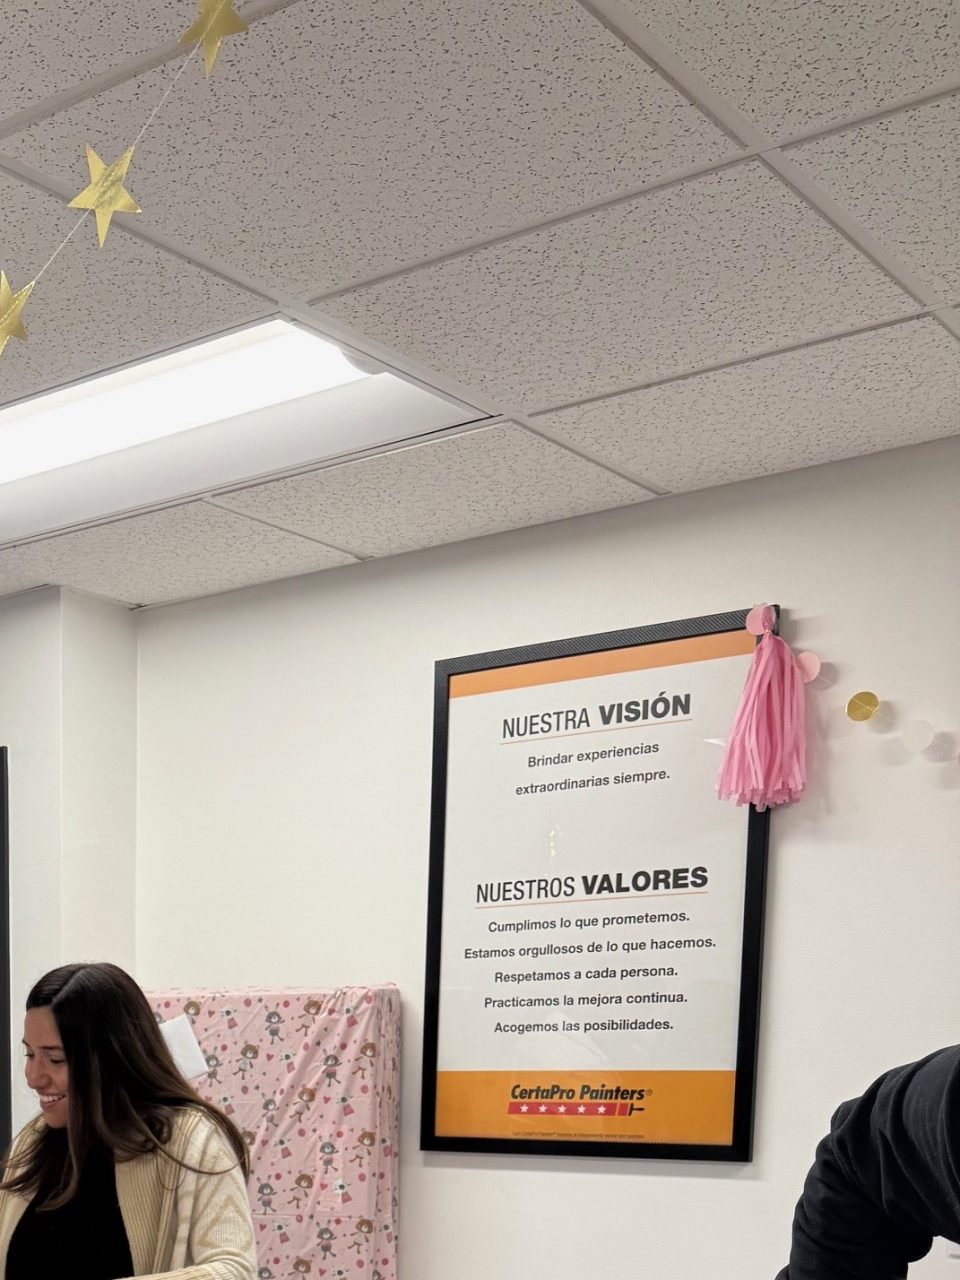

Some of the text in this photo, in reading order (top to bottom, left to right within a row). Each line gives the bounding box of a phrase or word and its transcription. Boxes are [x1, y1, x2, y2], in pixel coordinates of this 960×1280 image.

[502, 692, 691, 738] NUESTRA VISIÓN
[528, 742, 659, 768] Brindar experiencias
[516, 769, 670, 795] extraordinarias siempre.
[477, 867, 708, 903] NUESTROS VALORES
[488, 912, 690, 933] Cumplimos lo que prometemos.
[464, 937, 716, 959] Estamos orgullosos de lo que hacemos.
[494, 966, 678, 984] Respetamos a cada persona.
[484, 991, 687, 1009] Practicamos la mejora continua.
[494, 1018, 673, 1034] Acogemos las posibilidades.
[511, 1084, 575, 1100] CertaPro
